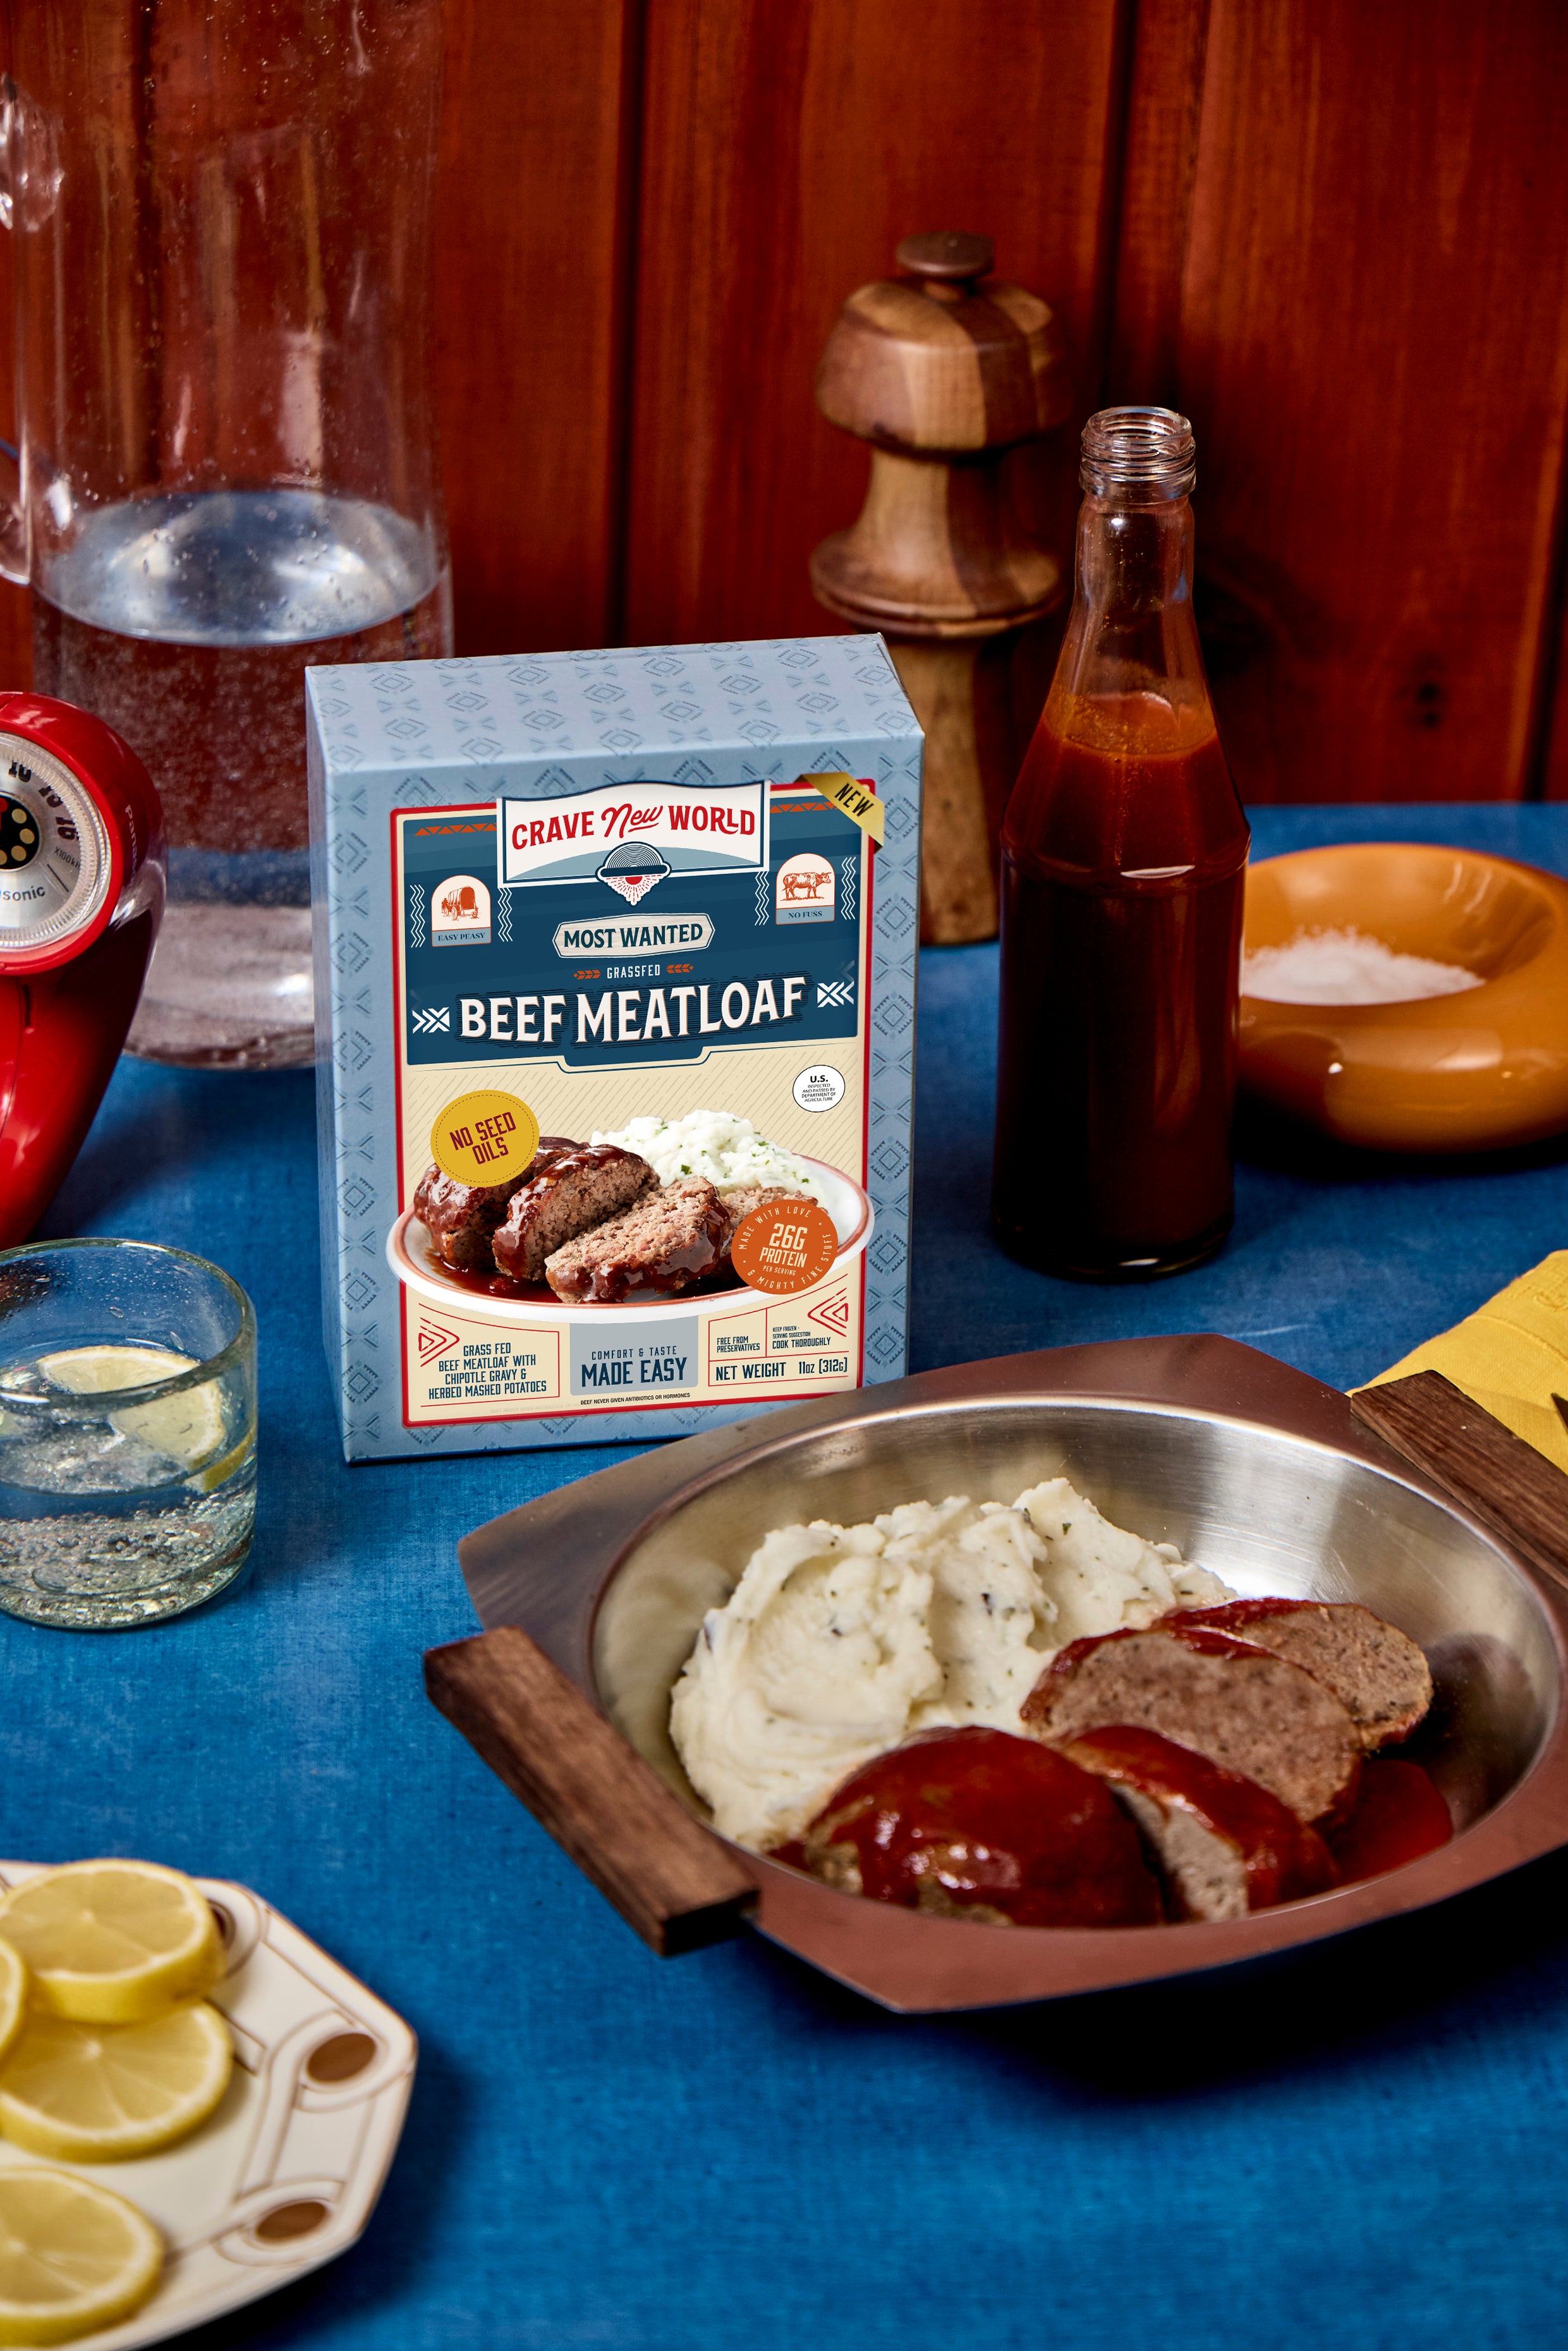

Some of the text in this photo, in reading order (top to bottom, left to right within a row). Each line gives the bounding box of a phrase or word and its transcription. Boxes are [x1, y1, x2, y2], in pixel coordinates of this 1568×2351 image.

[834, 783, 875, 817] NEW
[512, 803, 755, 850] CRAVE New WORLD
[0, 885, 46, 901] sonic
[564, 923, 703, 948] MOST WANTED
[607, 964, 660, 979] GRASSFED
[459, 976, 806, 1043] BEEF MEATLOAF
[449, 1112, 516, 1151] NO SEED
[472, 1137, 509, 1165] OILS
[738, 1206, 812, 1249] MADE WITH LOVE
[769, 1223, 808, 1251] 26G
[757, 1276, 794, 1290] MIGHTY
[801, 1266, 822, 1284] FINE
[821, 1234, 832, 1262] STUFF
[759, 1247, 808, 1268] PROTEIN
[774, 1267, 796, 1276] SERVING
[463, 1342, 511, 1356] GRASS FED
[717, 1335, 749, 1346] FREE FROM
[717, 1343, 760, 1353] PRESERVATIVES
[772, 1337, 831, 1349] COOK THOROUGHLY
[439, 1354, 536, 1371] BEEF MEATLOAF WITH
[592, 1346, 677, 1360] COMFORT & TASTE
[445, 1368, 526, 1385] CHIPOTLE GRAVY &
[581, 1357, 688, 1387] MADE EASY
[715, 1366, 738, 1381] NET
[742, 1362, 787, 1379] WEIGHT
[428, 1380, 547, 1399] HERBED MASHED POTATOES
